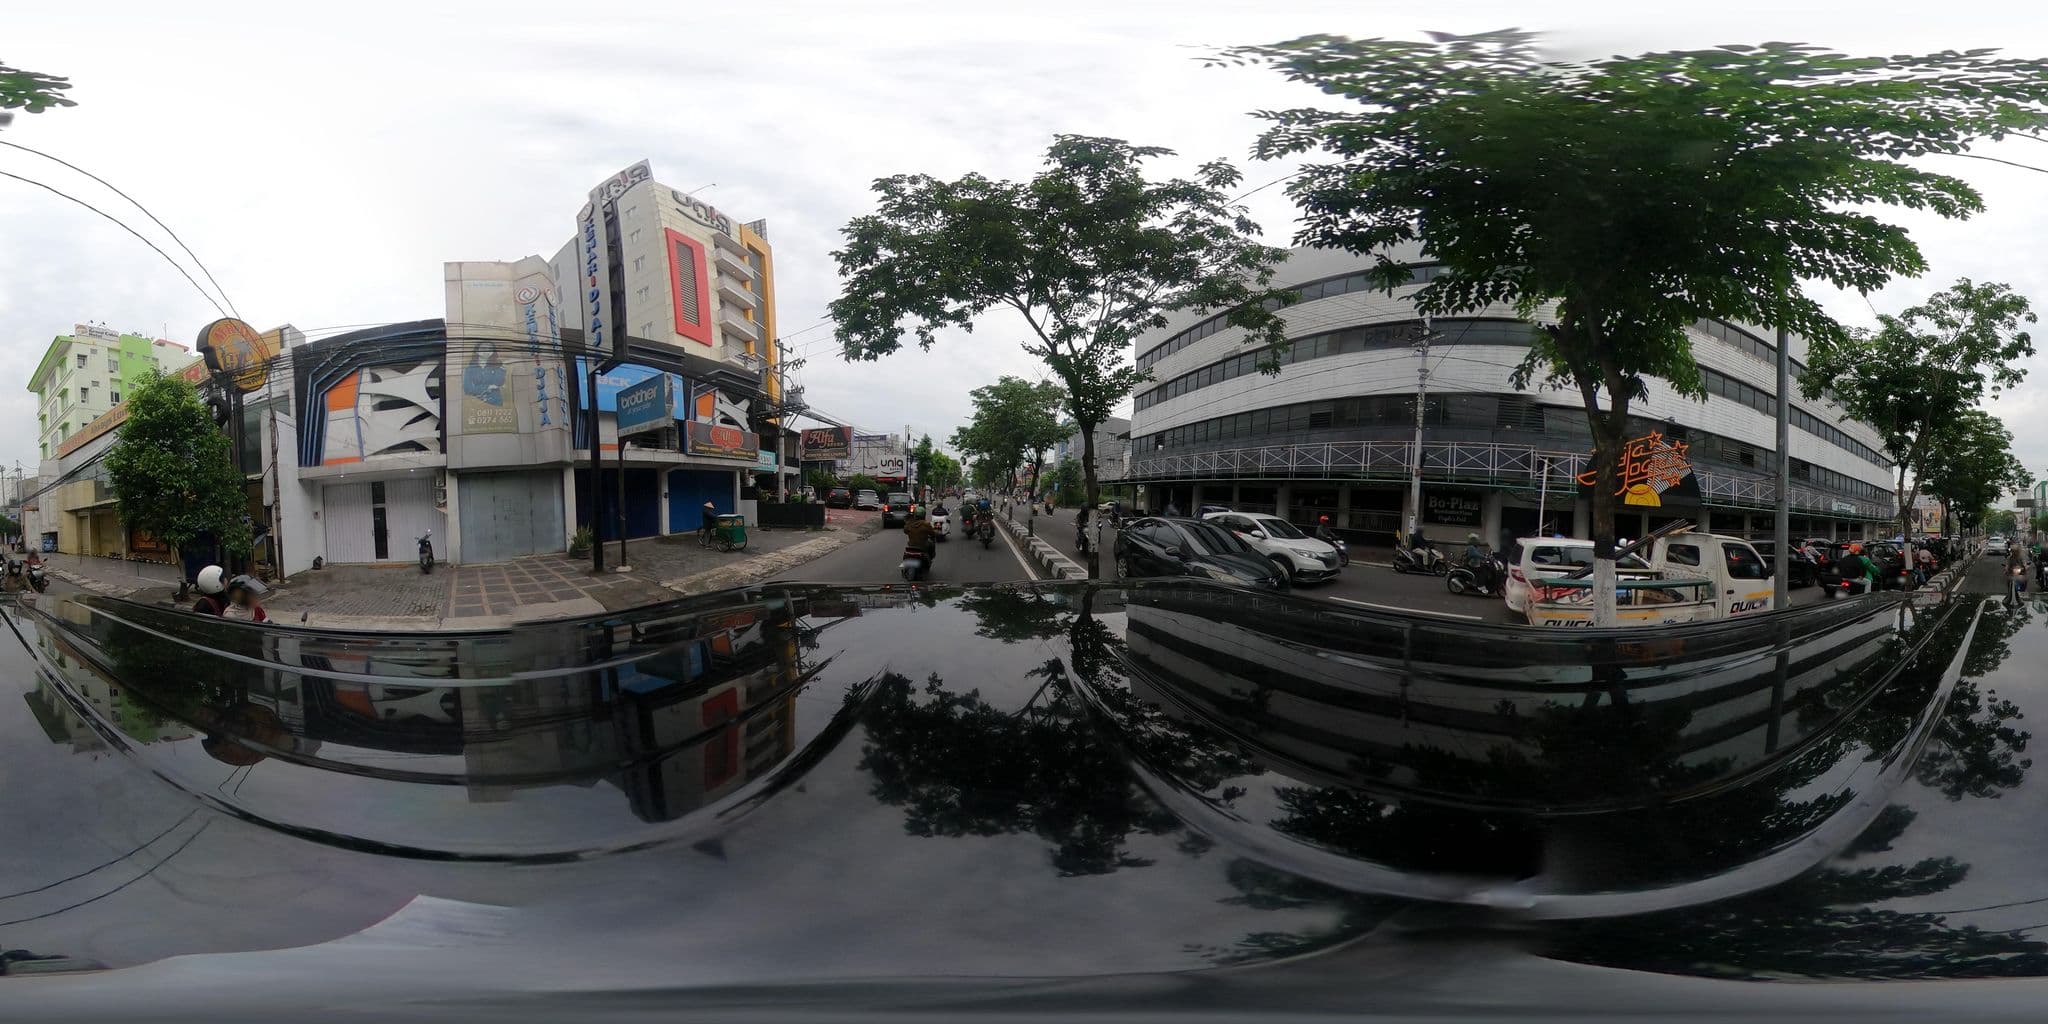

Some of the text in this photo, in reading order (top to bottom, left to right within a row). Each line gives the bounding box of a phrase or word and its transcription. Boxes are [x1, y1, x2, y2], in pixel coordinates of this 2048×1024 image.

[621, 386, 657, 409] brother
[807, 430, 834, 448] Alfa
[880, 457, 903, 471] uniq
